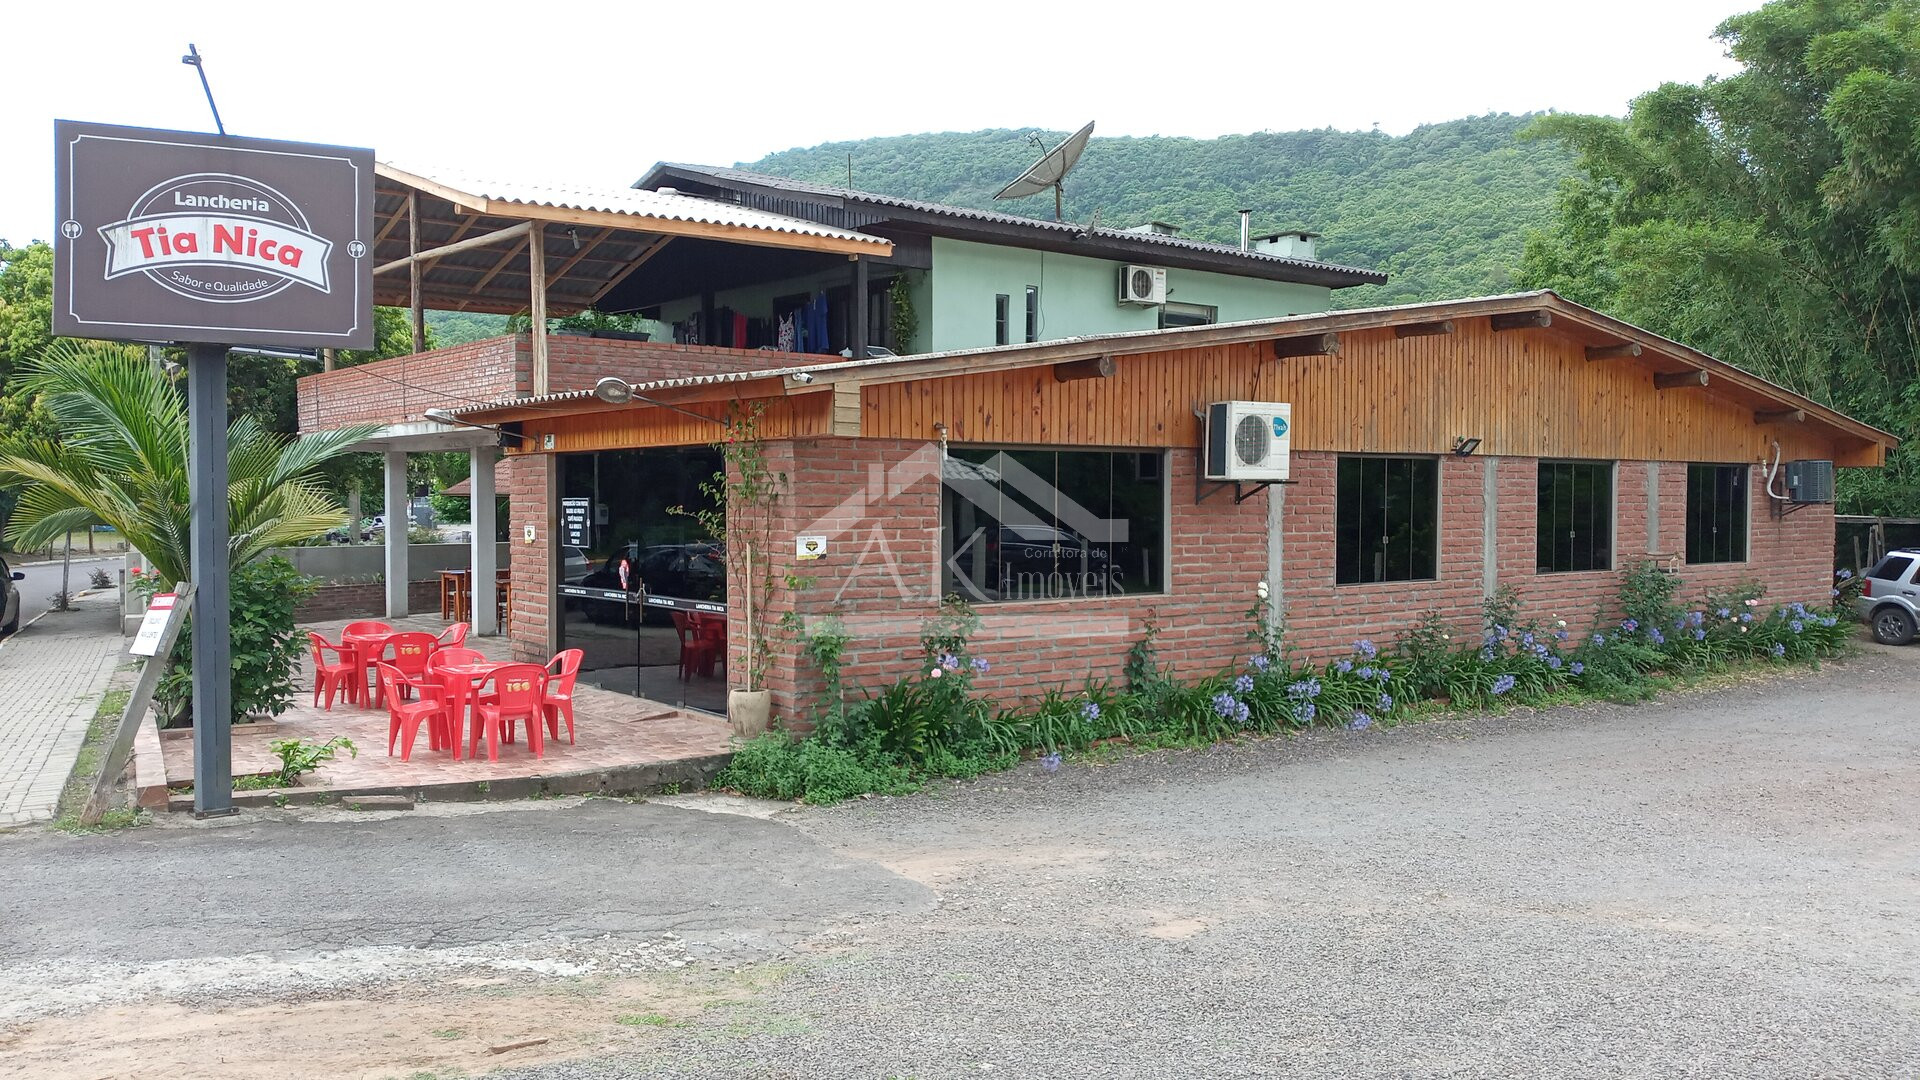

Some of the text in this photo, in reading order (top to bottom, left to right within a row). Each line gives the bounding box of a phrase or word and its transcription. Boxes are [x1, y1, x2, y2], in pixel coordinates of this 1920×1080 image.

[174, 191, 270, 213] Lancheria
[130, 223, 305, 269] Tia Nica
[171, 269, 269, 293] Sabor e Qualidade
